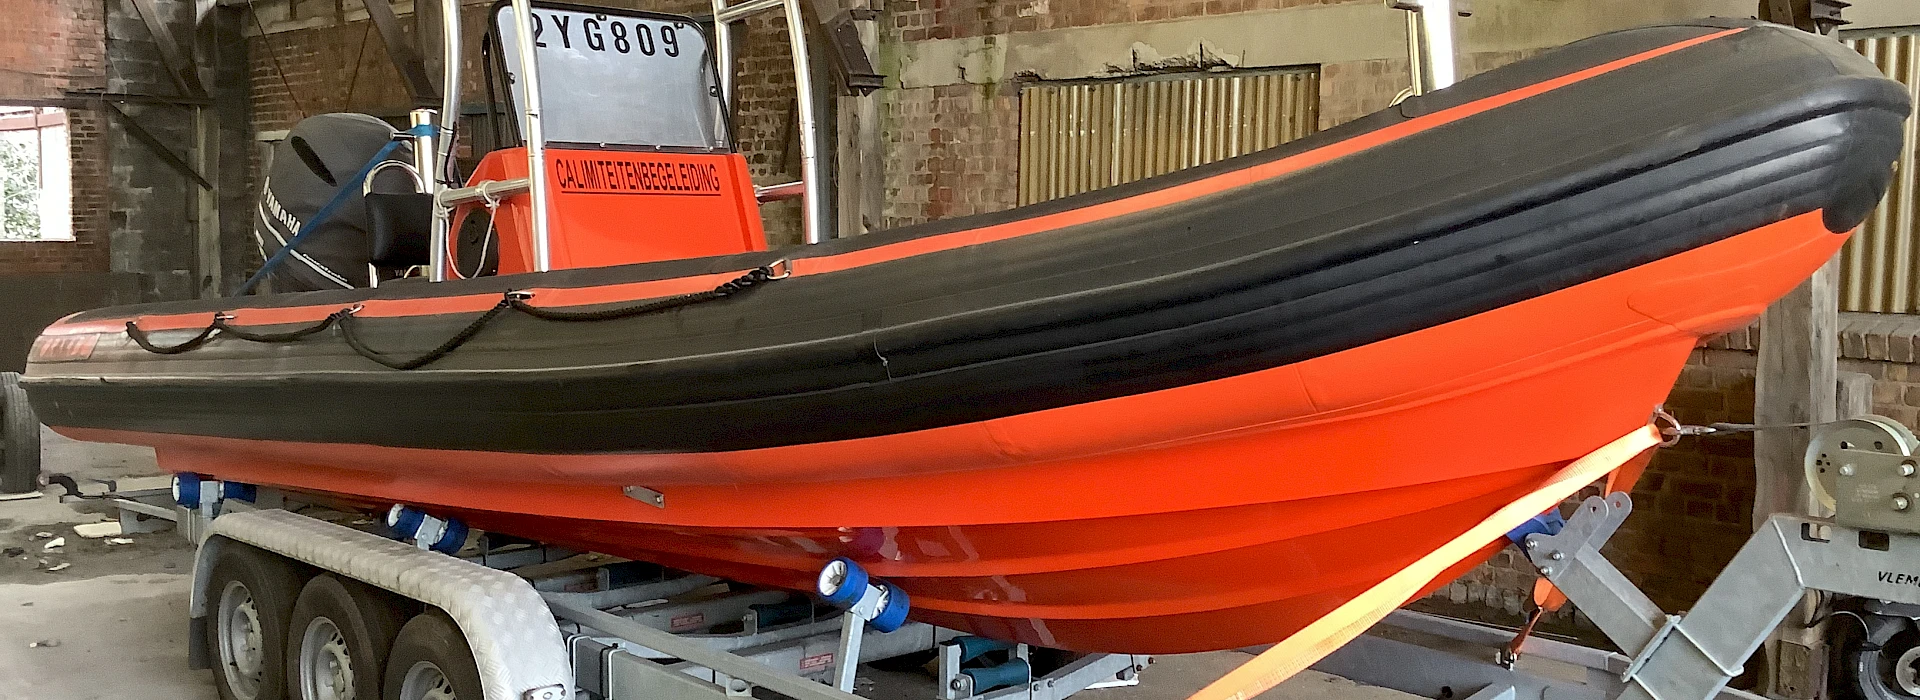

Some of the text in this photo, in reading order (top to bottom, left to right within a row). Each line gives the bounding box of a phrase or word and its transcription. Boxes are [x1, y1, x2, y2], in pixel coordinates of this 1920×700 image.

[556, 159, 720, 191] CALIMITEITENBEGELEIDING
[266, 188, 301, 237] YAMAHA
[1878, 570, 1920, 587] VLEM
